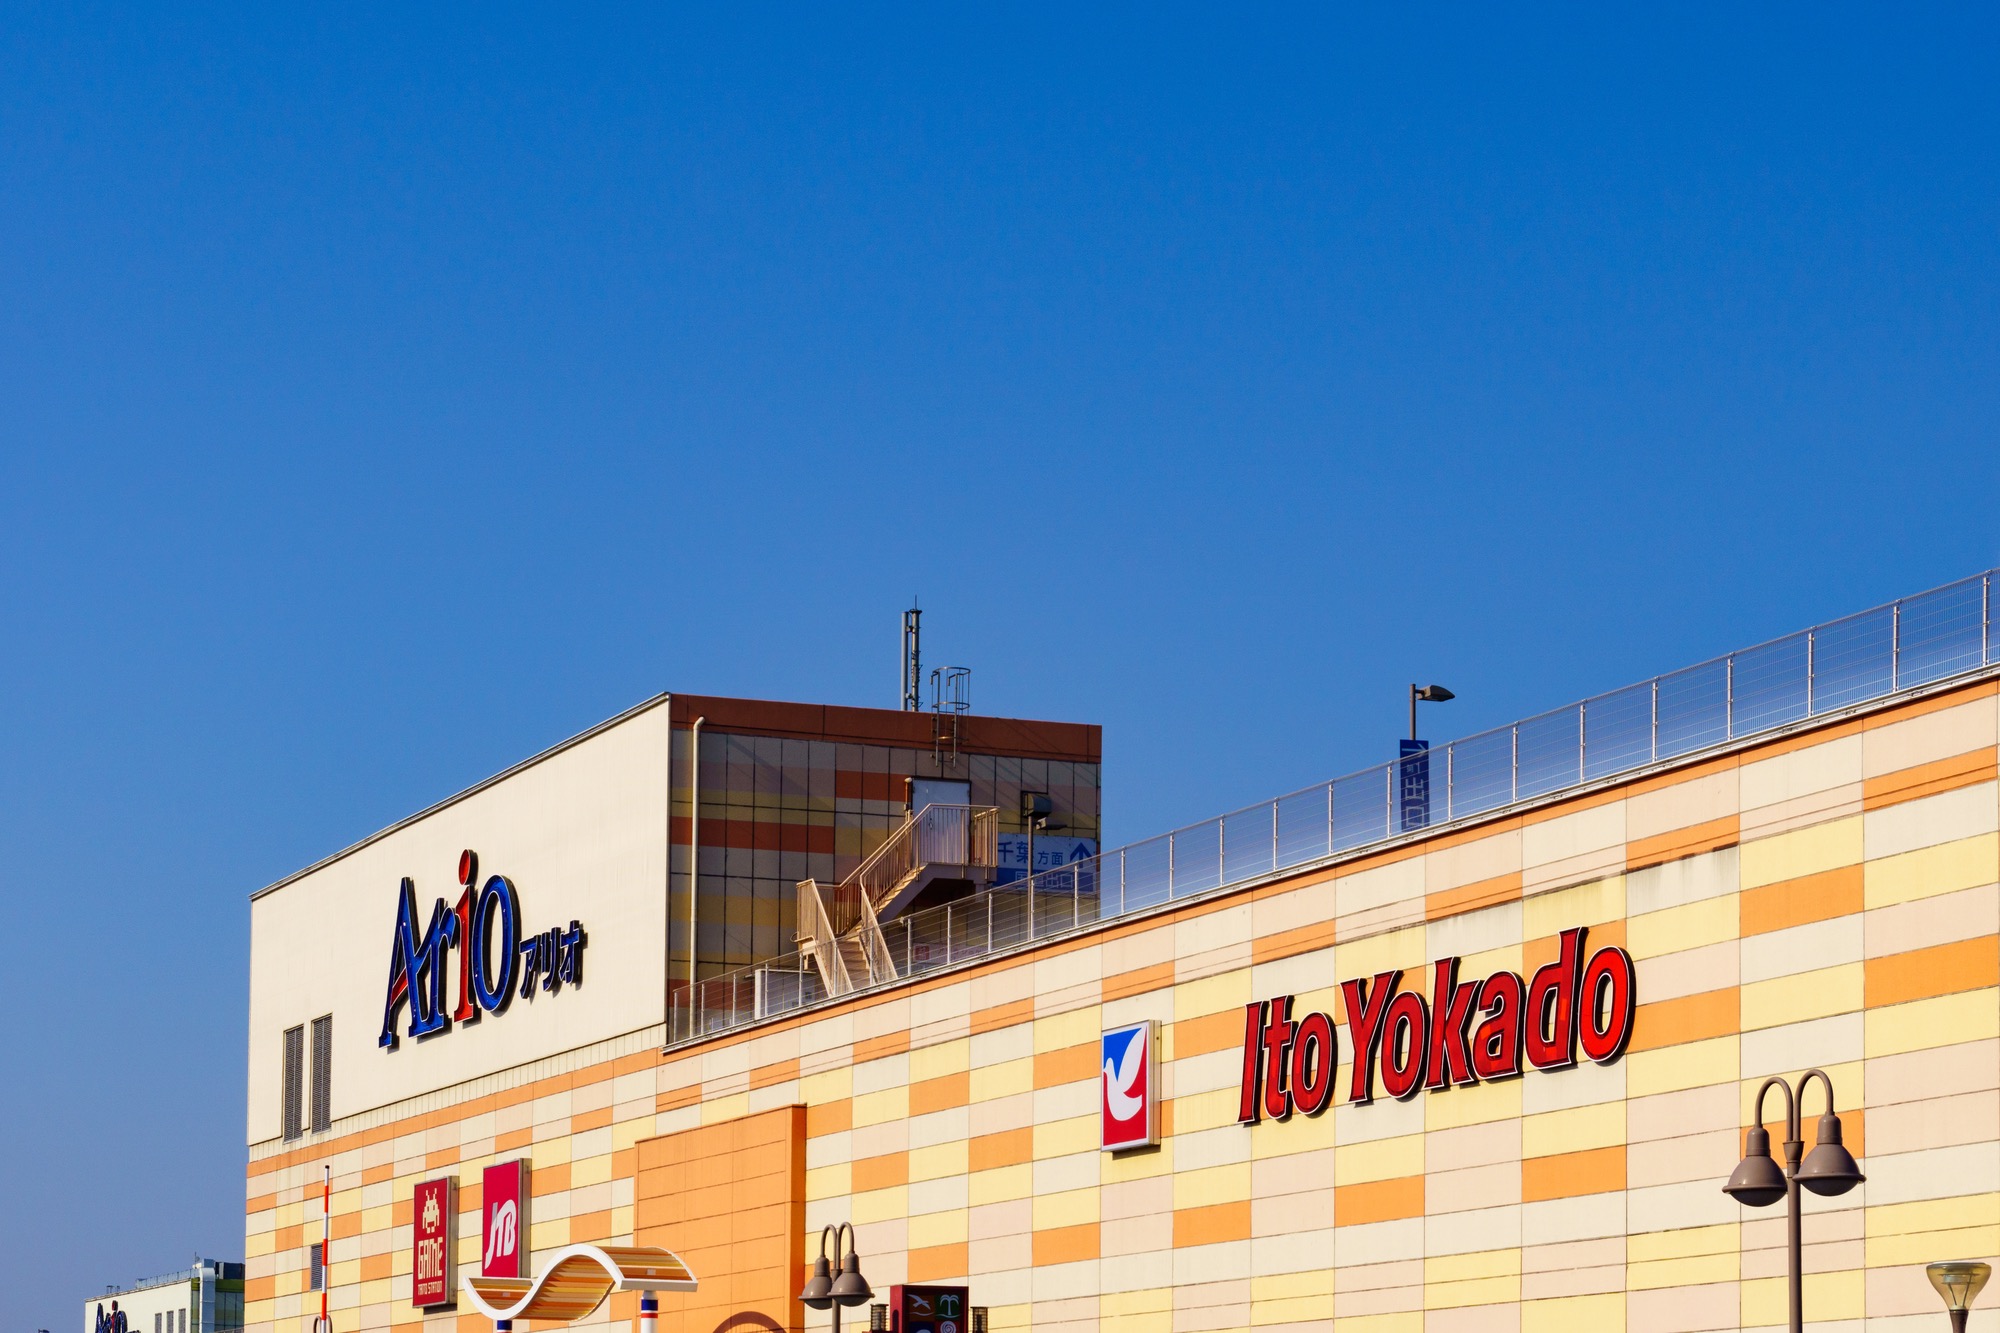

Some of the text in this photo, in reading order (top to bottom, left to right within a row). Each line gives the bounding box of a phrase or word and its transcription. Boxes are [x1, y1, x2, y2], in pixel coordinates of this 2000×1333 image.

[379, 849, 586, 1049] Ario アリオ
[418, 1237, 443, 1280] GAME
[485, 1199, 517, 1269] JTB
